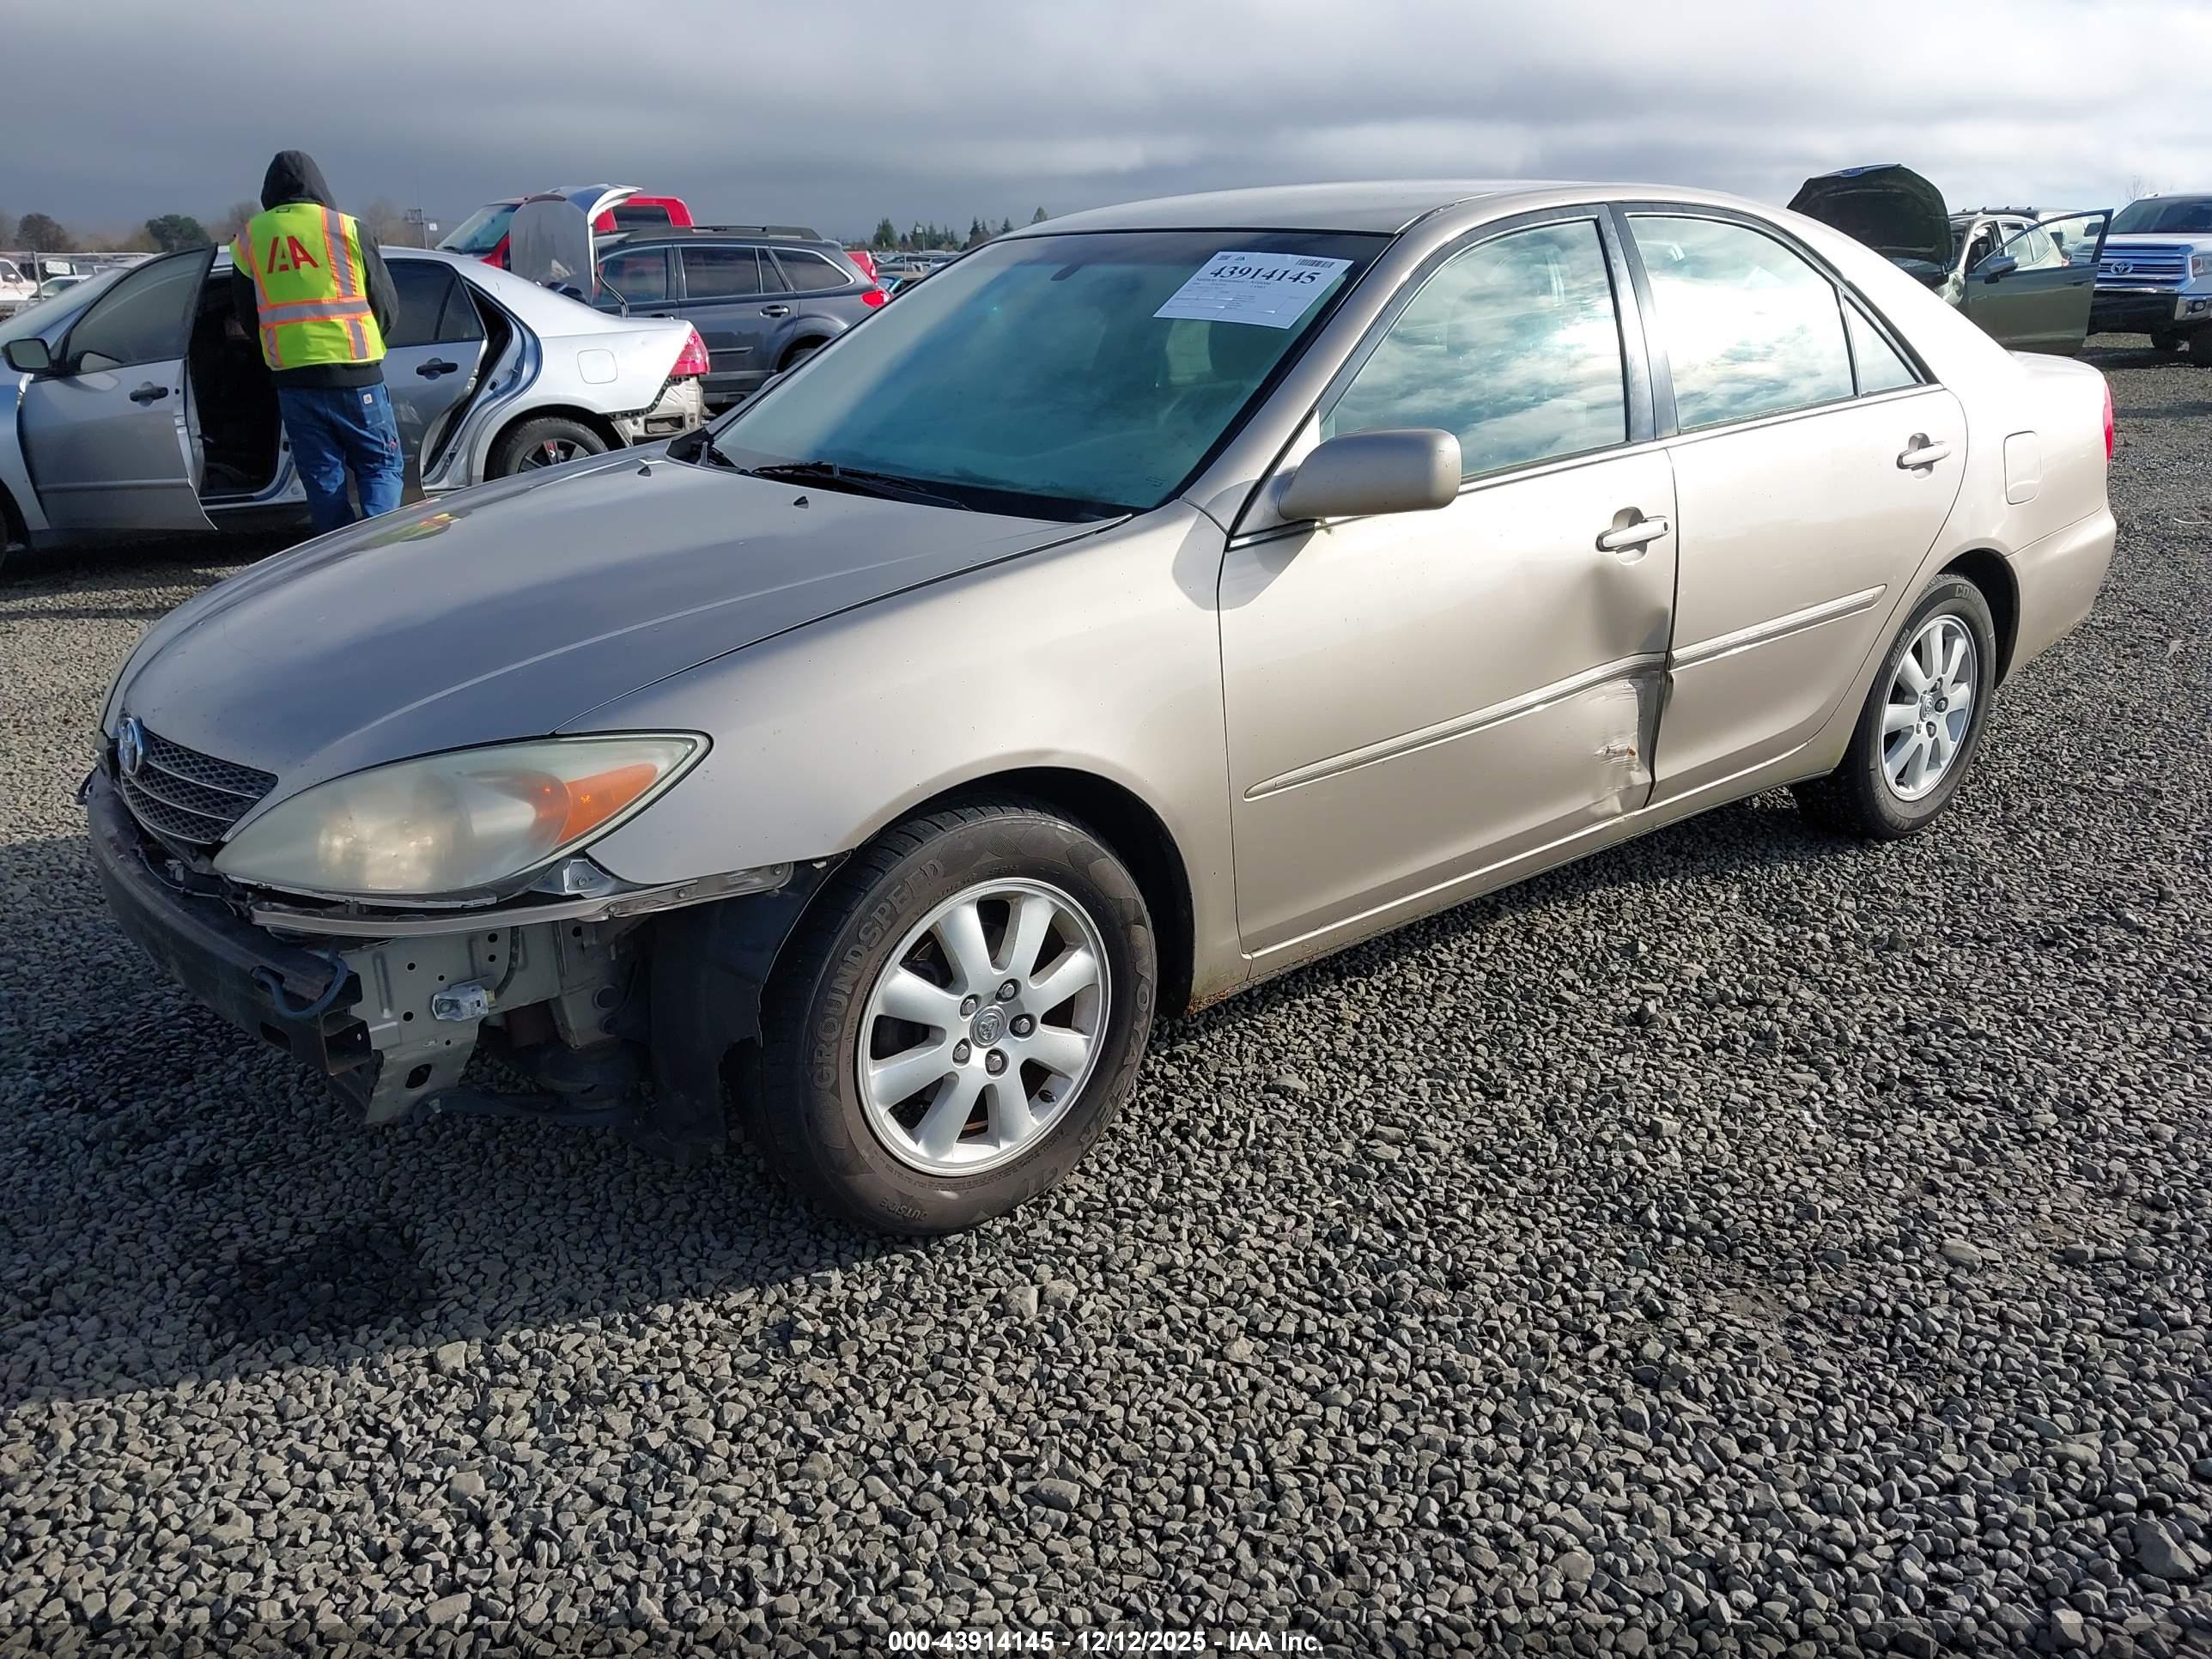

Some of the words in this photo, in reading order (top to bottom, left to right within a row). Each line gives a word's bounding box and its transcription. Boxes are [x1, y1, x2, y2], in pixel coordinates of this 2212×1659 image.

[1210, 265, 1322, 284] 43914145
[813, 860, 944, 1090] GROUNDSPEED
[878, 1197, 928, 1222] OUTSIDE
